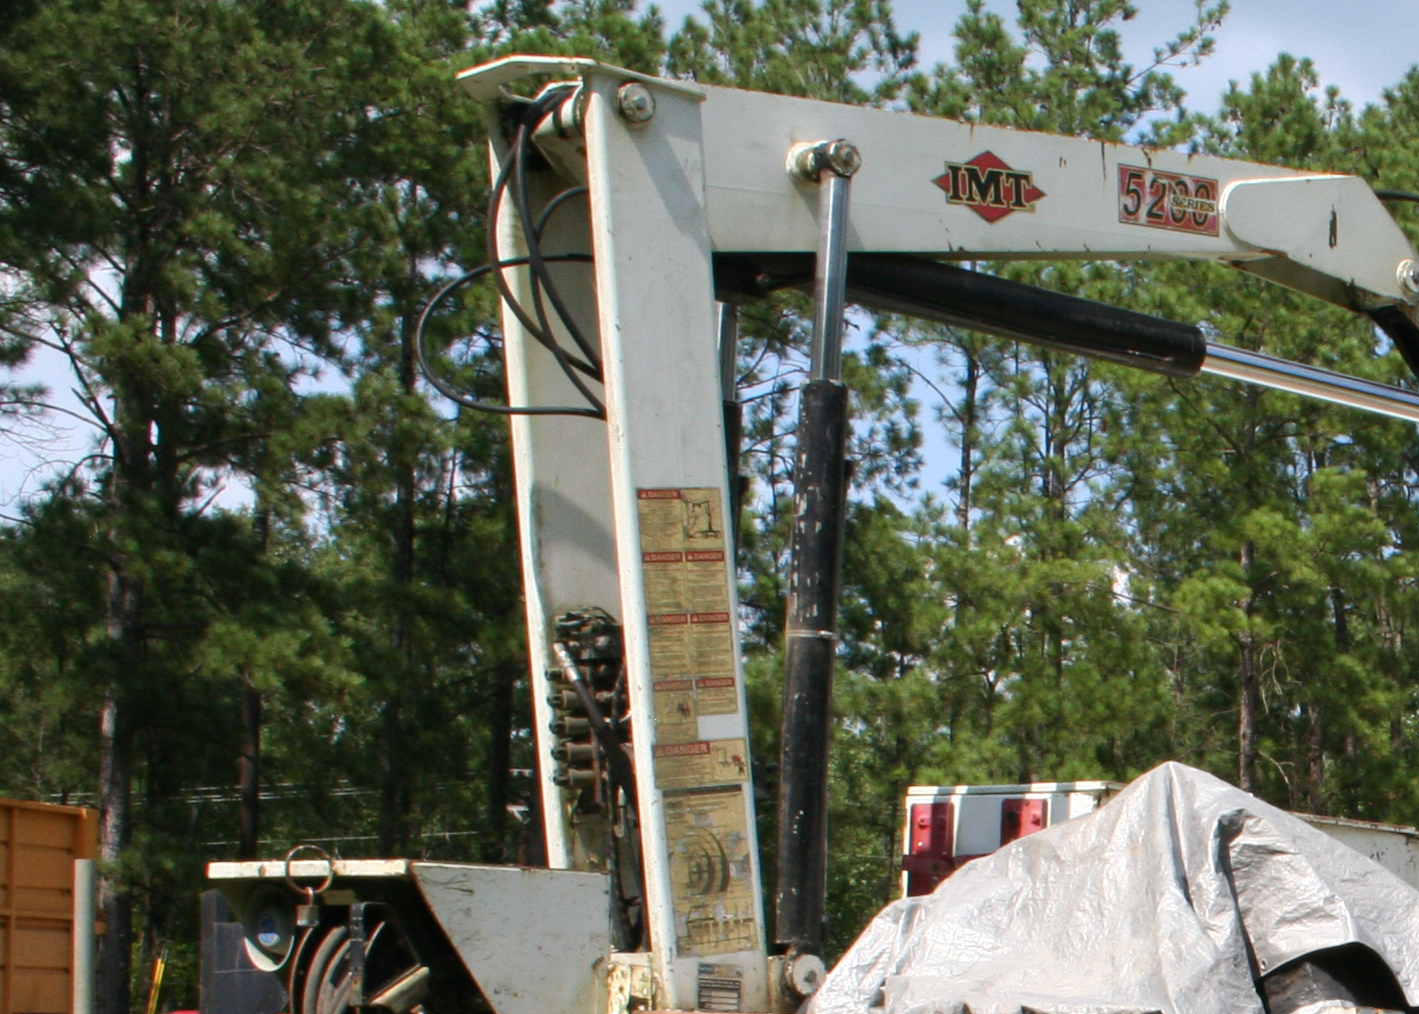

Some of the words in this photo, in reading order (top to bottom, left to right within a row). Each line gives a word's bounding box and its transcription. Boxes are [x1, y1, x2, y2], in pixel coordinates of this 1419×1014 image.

[946, 163, 1032, 209] IMT
[1171, 194, 1216, 213] SERIES
[664, 743, 708, 756] DANGER
